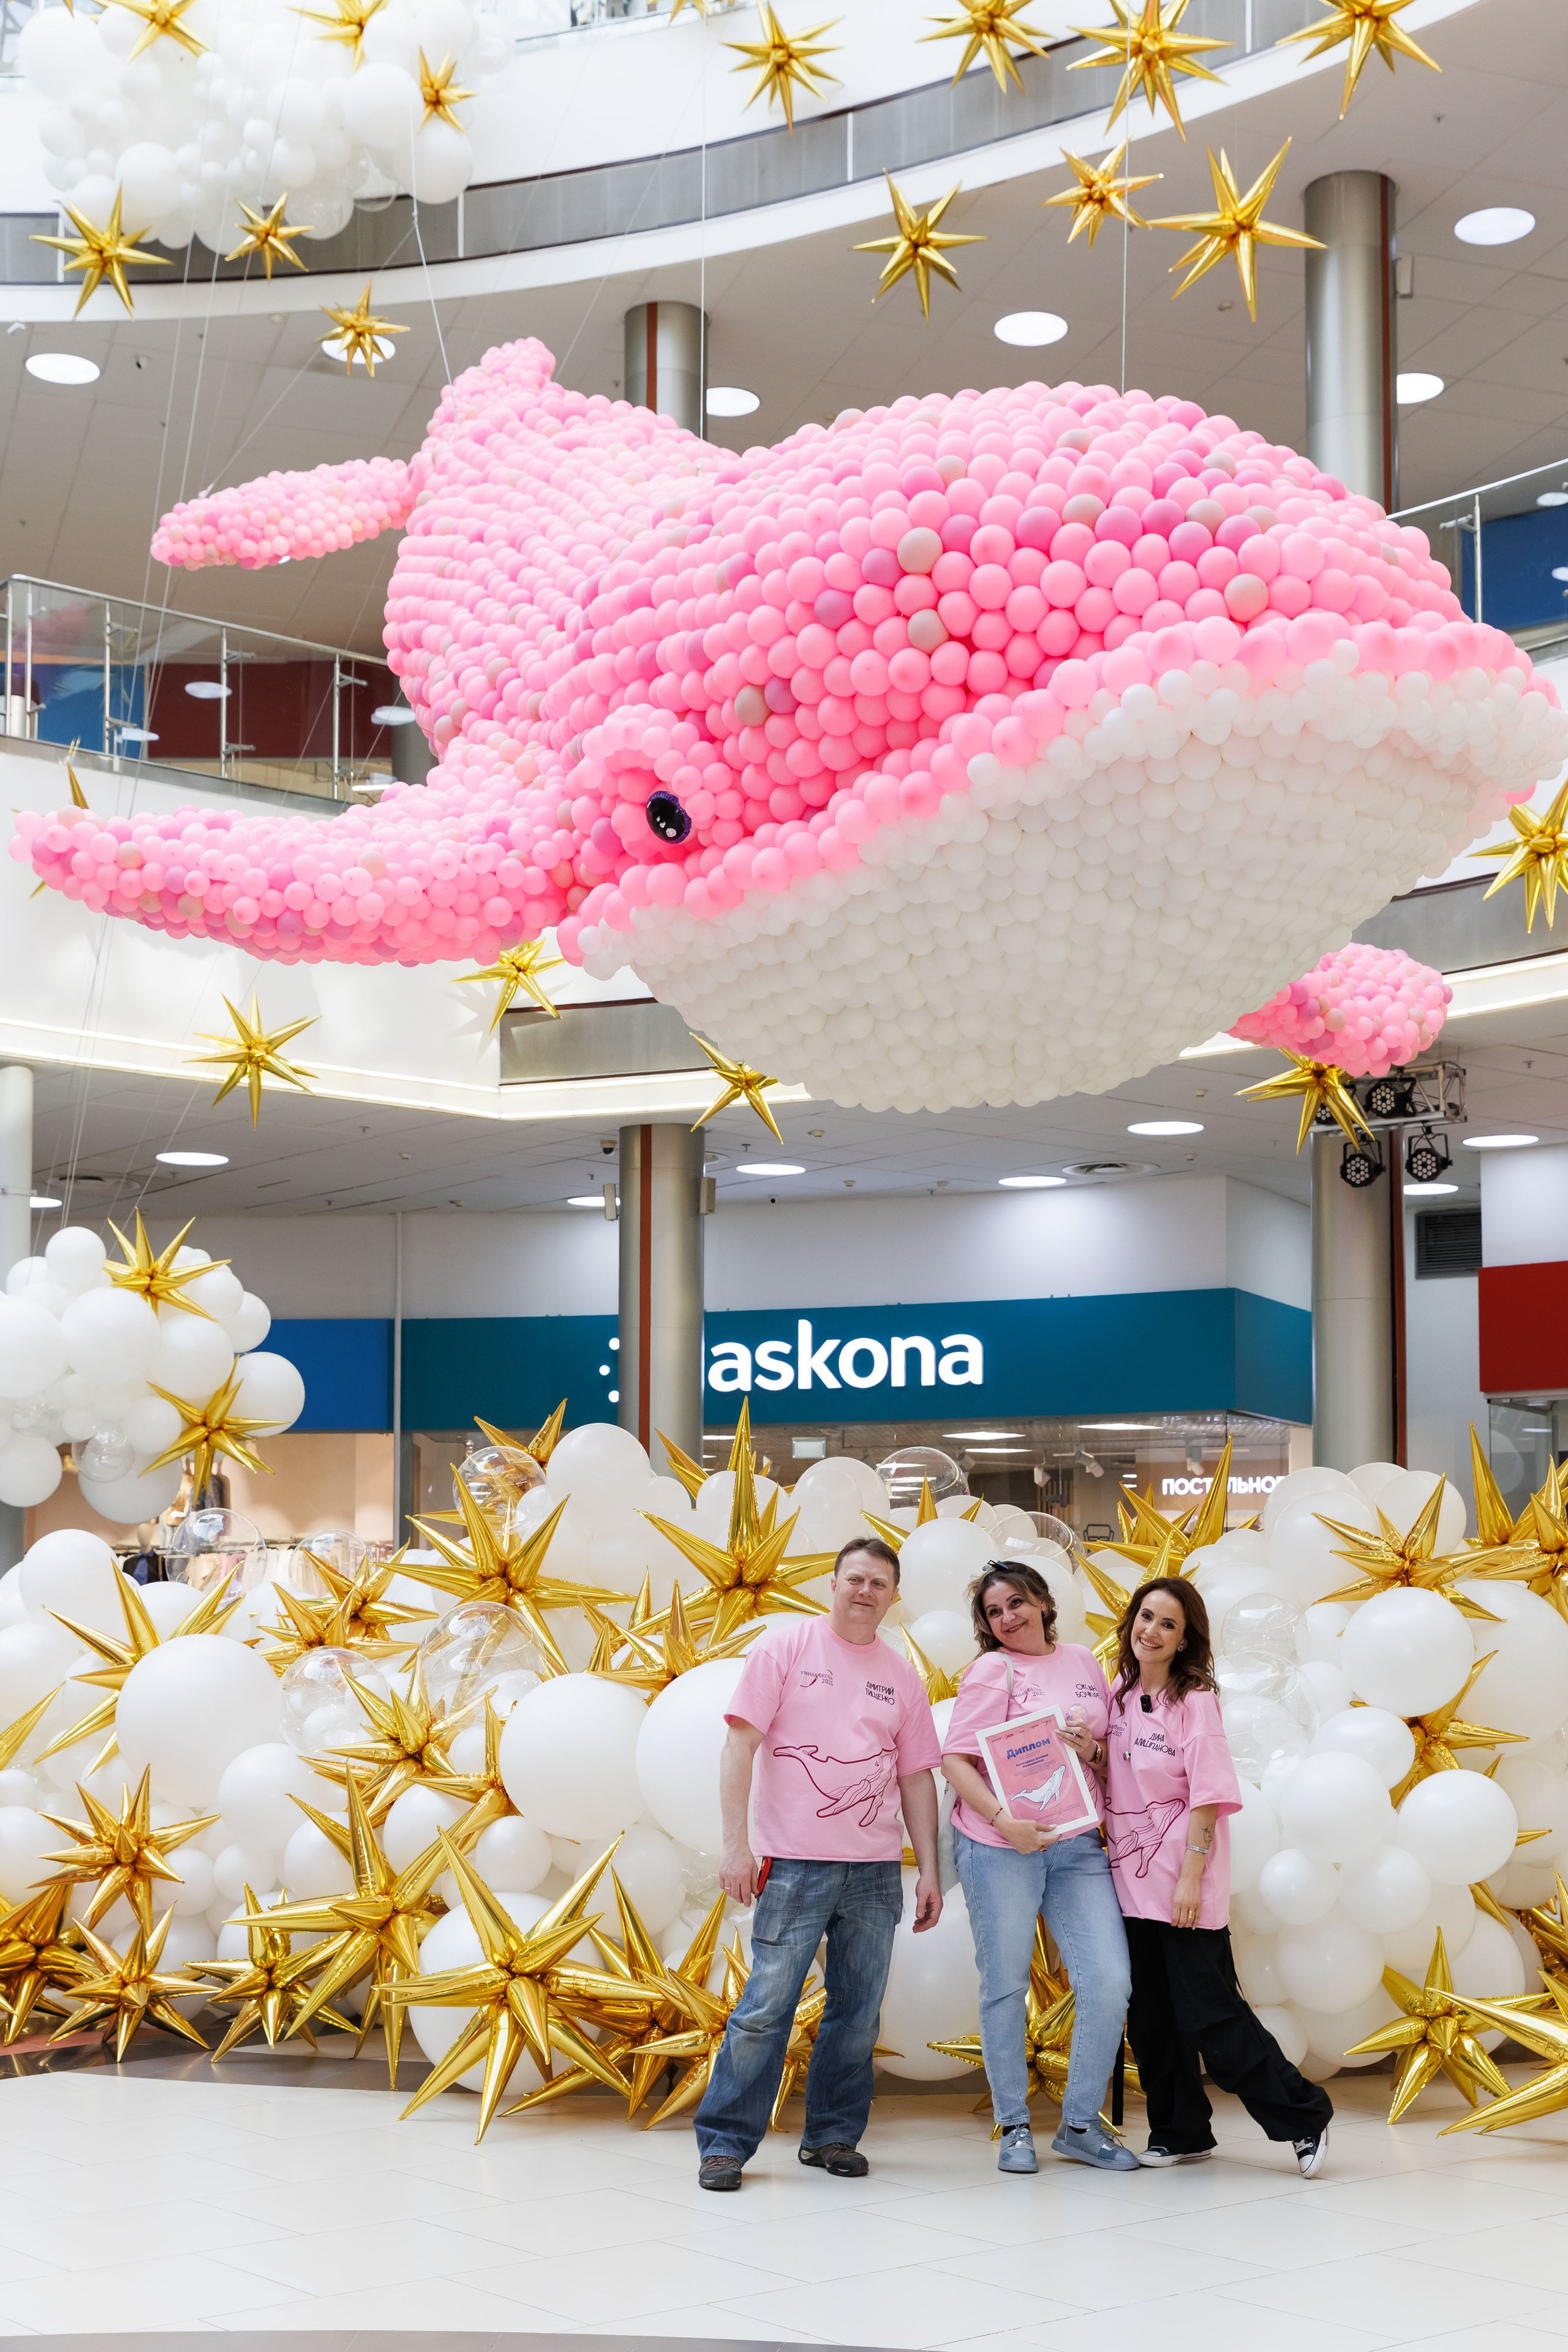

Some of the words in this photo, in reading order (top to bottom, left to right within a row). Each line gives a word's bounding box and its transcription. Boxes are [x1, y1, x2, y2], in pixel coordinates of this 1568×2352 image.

[708, 1319, 984, 1392] askona
[1162, 1476, 1286, 1496] ПОСТЛЬНО
[865, 1687, 895, 1705] ТИЩЕНКО
[866, 1681, 894, 1696] ДМИТРИЙ
[1134, 1737, 1176, 1757] АЛИШПАНОВА
[1148, 1733, 1164, 1743] ДИНА
[1006, 1738, 1050, 1760] Диплом
